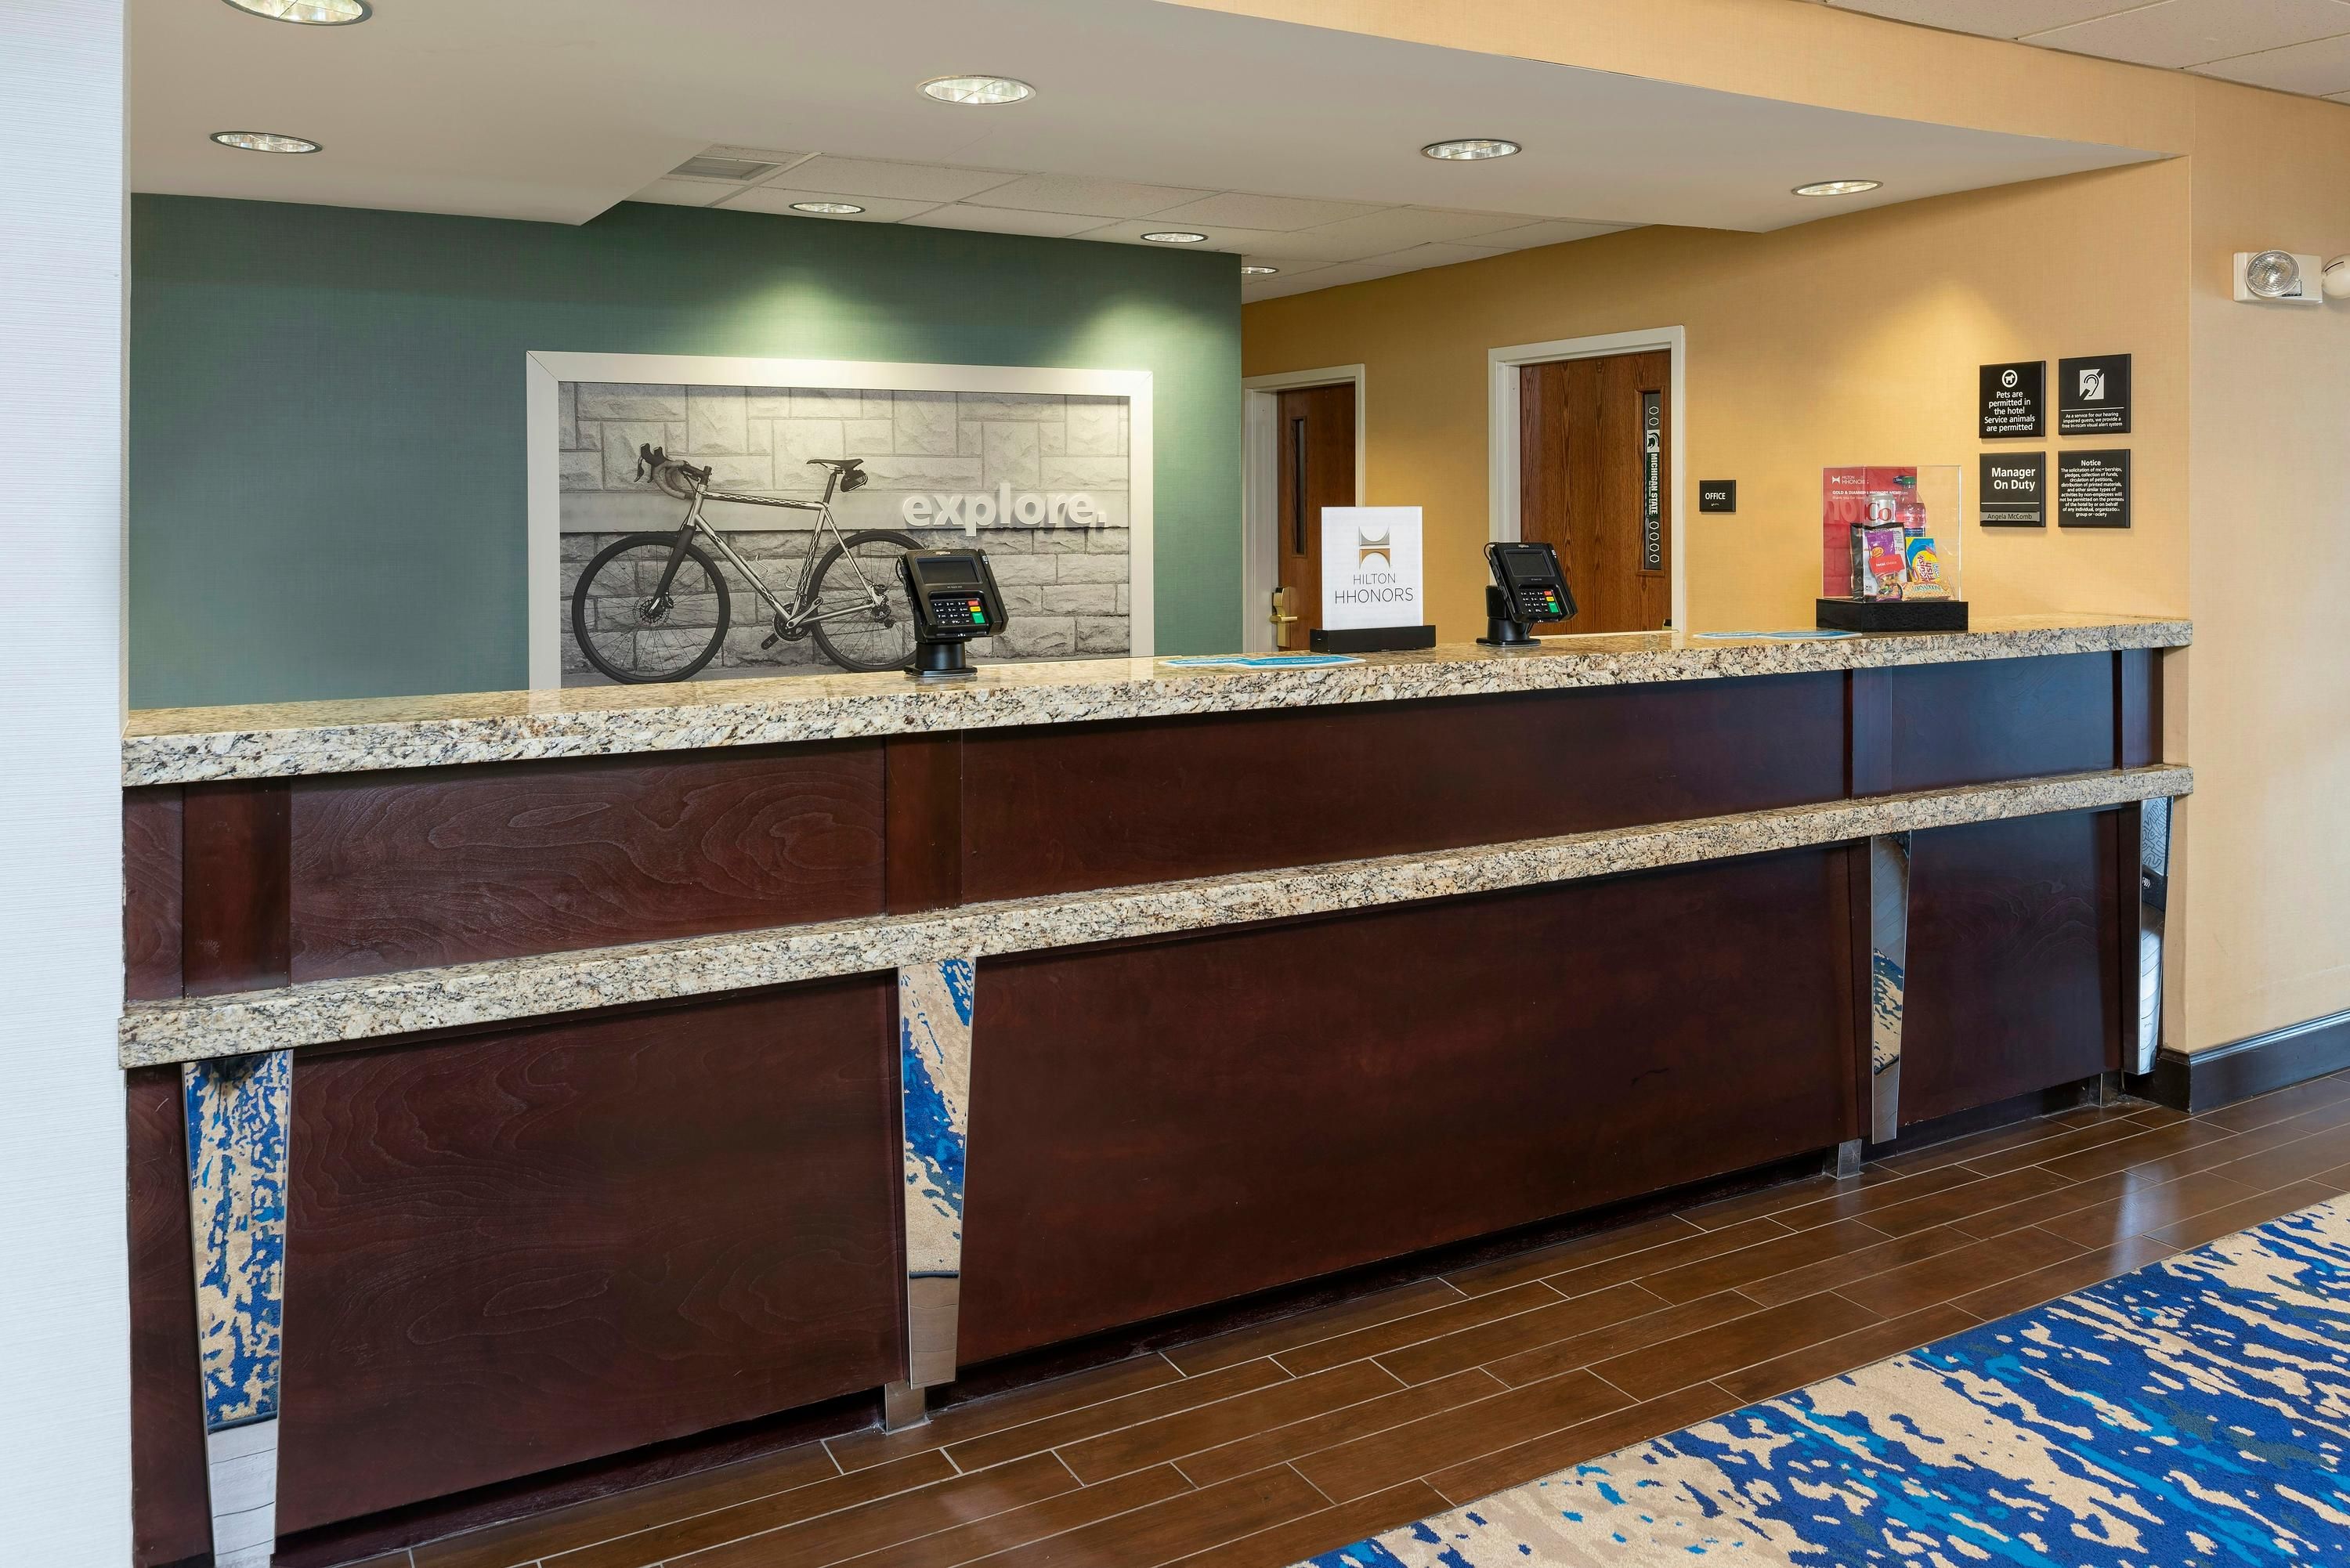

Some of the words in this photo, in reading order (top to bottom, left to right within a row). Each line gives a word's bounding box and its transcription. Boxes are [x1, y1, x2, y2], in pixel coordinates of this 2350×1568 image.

[1989, 398, 2022, 409] permitted
[1999, 423, 2033, 432] permitted
[1991, 467, 2036, 479] Manager
[1994, 479, 2008, 490] On
[2011, 479, 2036, 492] Duty
[902, 482, 1106, 537] explore.
[1354, 573, 1396, 585] HILTON
[1335, 587, 1414, 604] HHONORS
